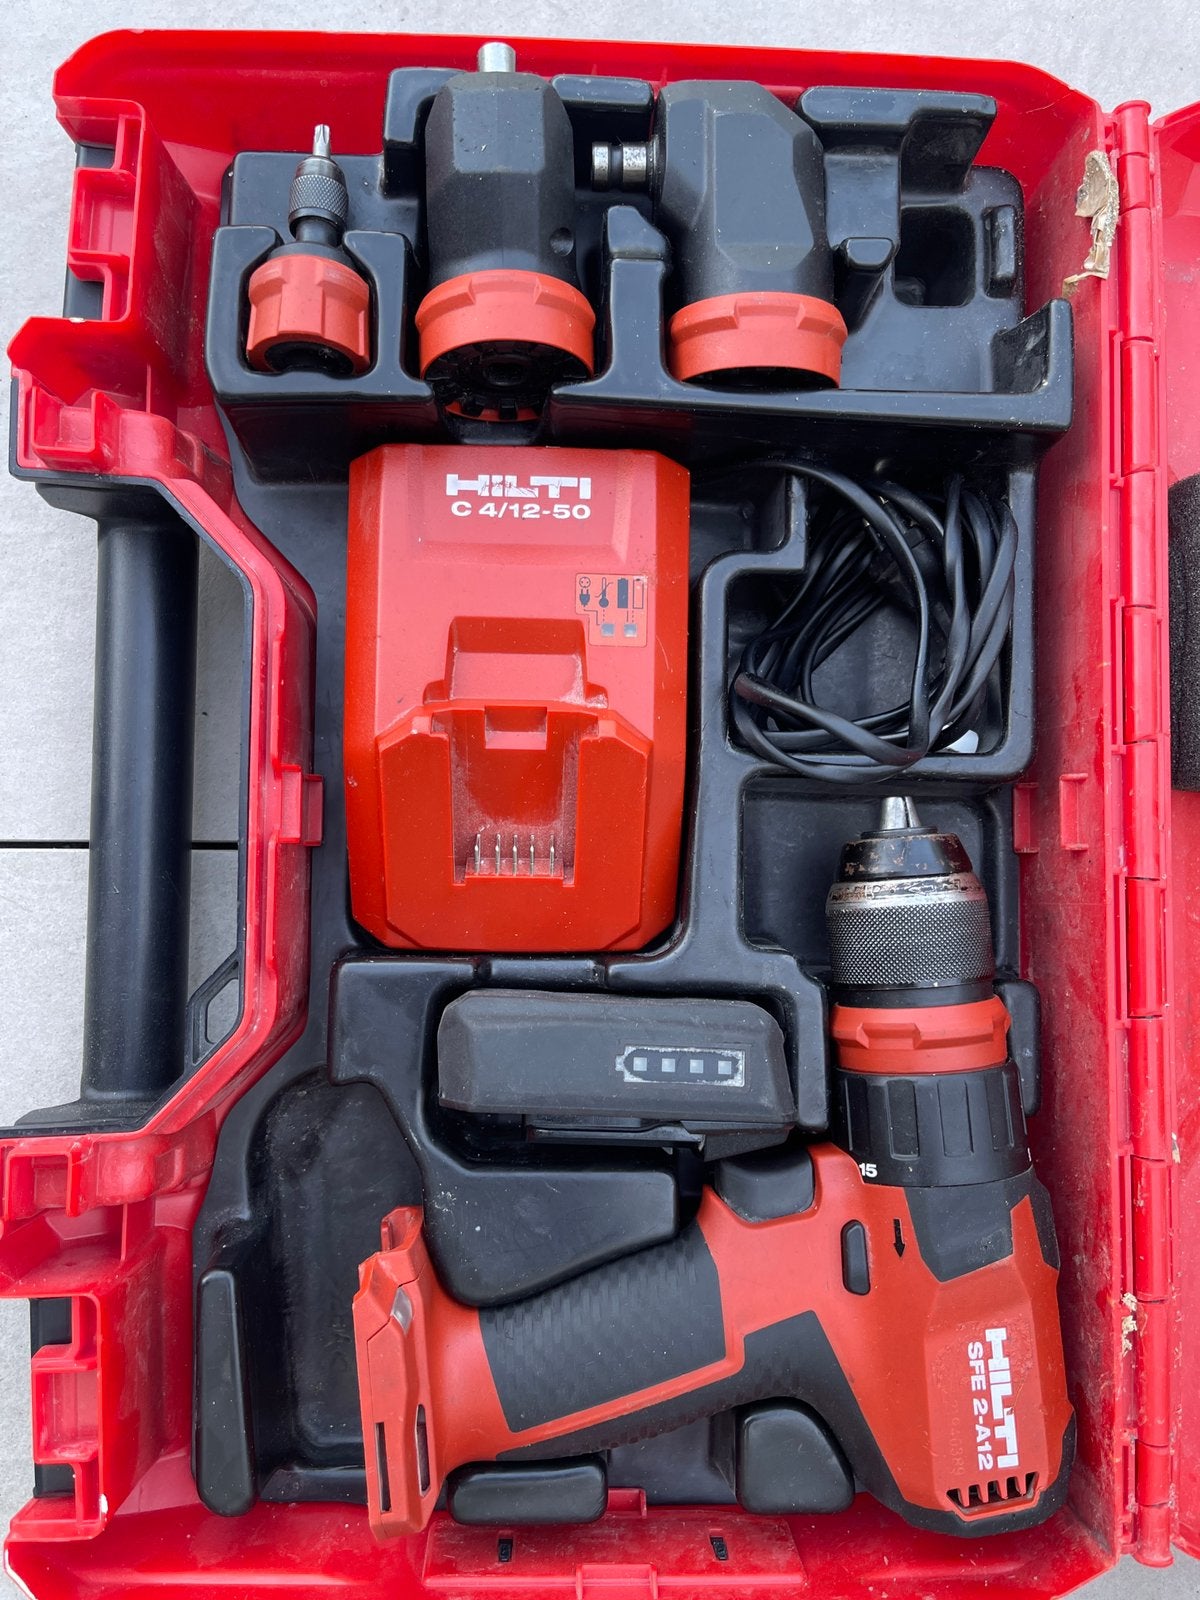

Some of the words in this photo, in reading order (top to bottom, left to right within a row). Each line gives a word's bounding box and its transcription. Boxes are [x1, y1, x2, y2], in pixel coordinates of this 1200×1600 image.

[446, 474, 591, 499] HILTI
[451, 501, 472, 517] C
[478, 502, 591, 519] 4/12-50
[859, 1162, 878, 1178] 15
[967, 1341, 987, 1392] SFE
[985, 1327, 1019, 1468] HILTI
[973, 1398, 994, 1471] 2-A12
